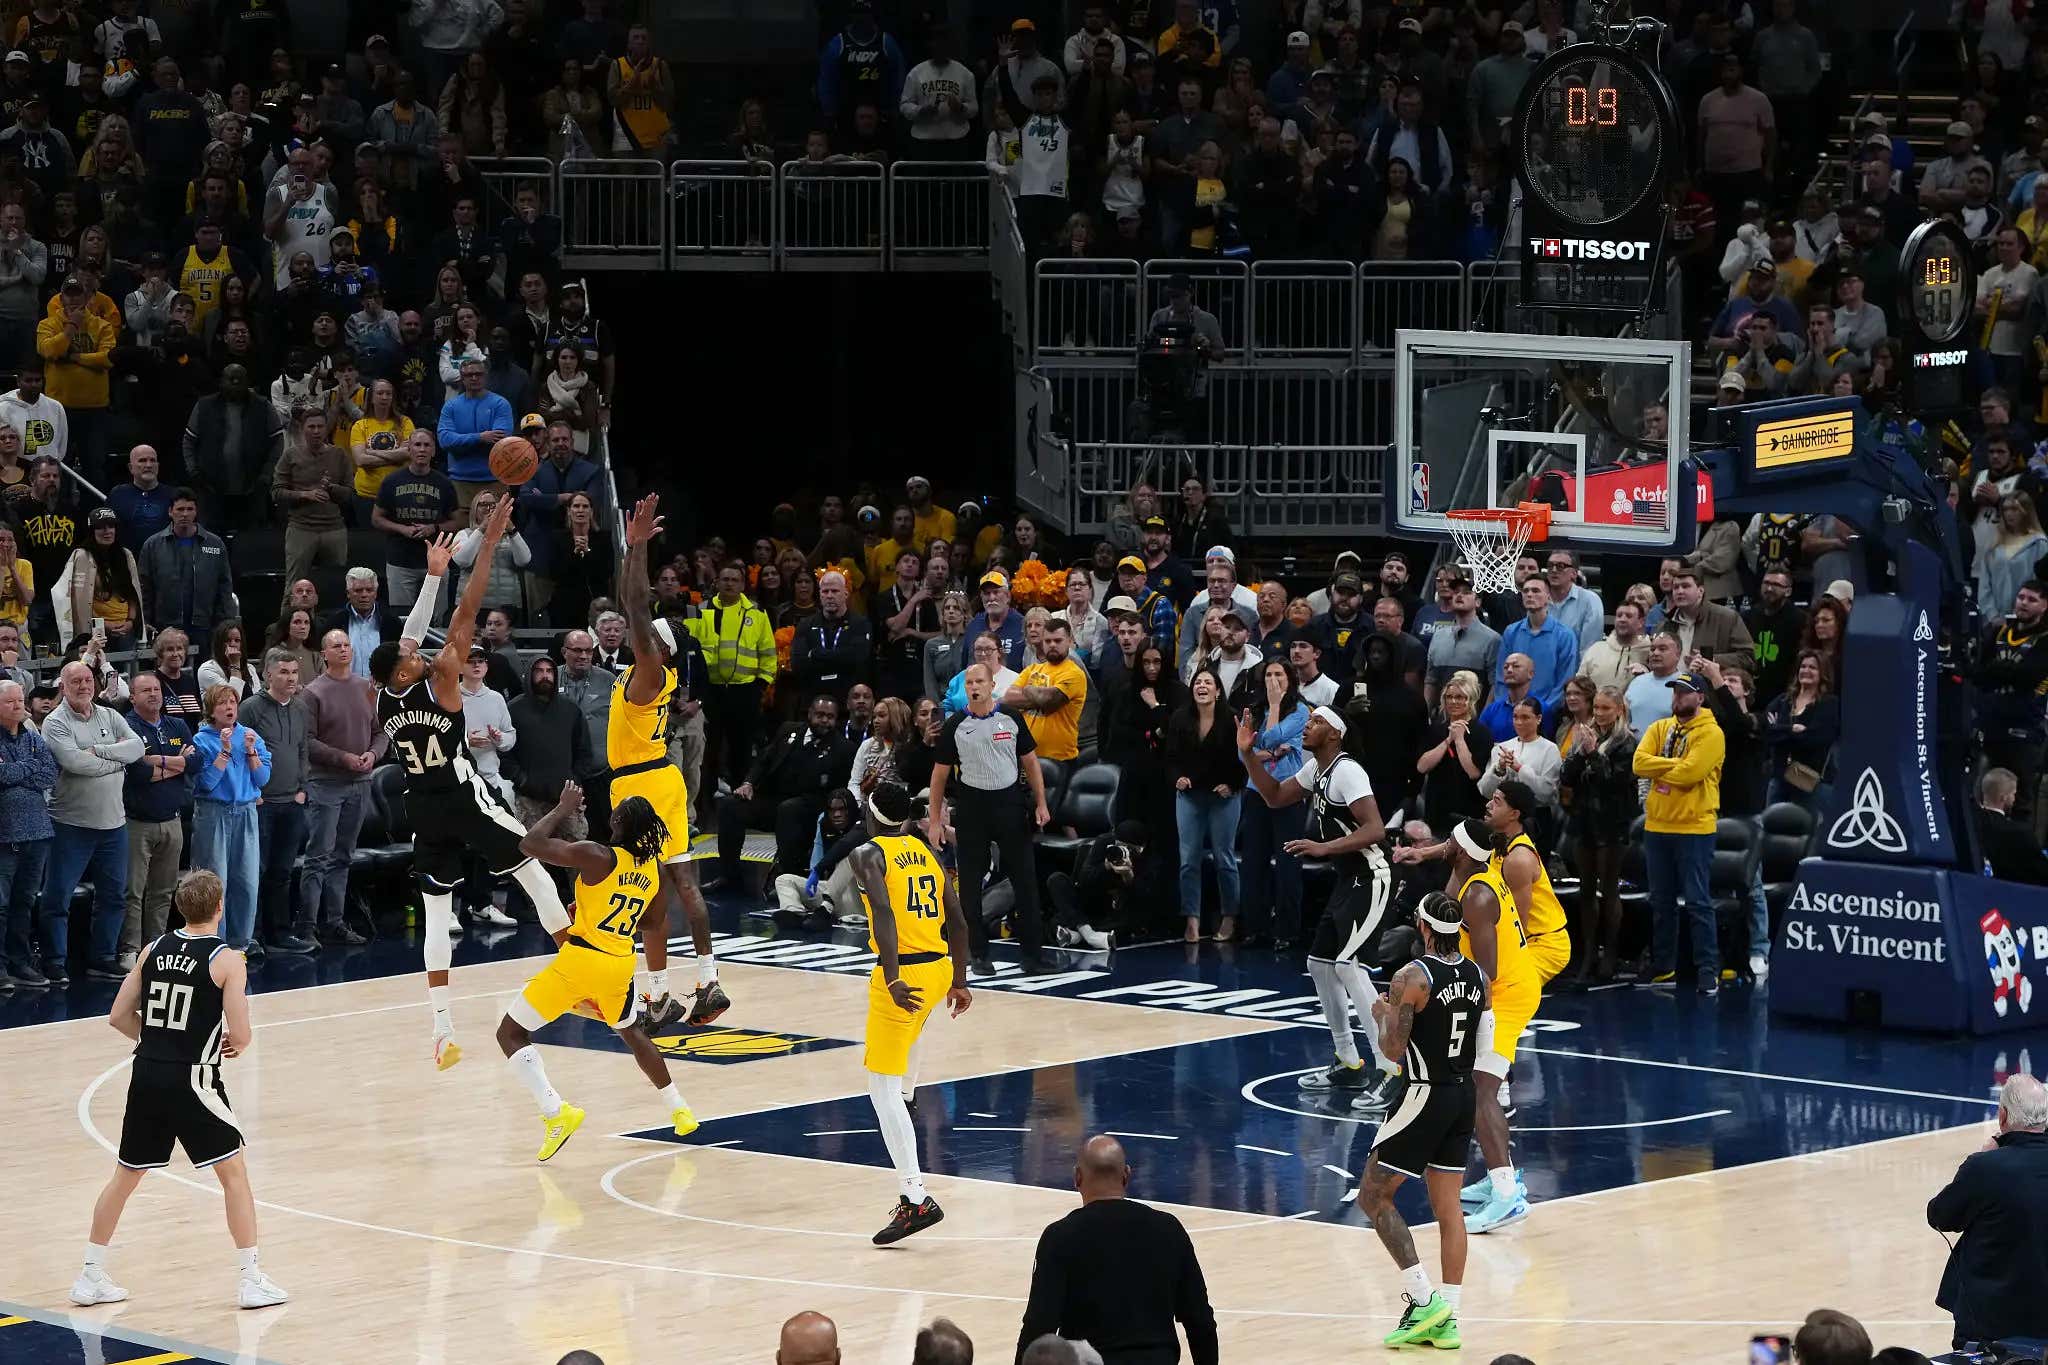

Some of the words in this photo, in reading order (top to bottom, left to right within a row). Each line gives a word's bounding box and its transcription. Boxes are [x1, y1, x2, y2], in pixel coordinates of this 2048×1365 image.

[848, 50, 879, 63] INDY
[921, 79, 960, 97] PACERS
[1568, 87, 1617, 126] 0.9
[1040, 139, 1058, 151] 43
[305, 222, 326, 237] 26
[1563, 240, 1651, 260] TISSOT
[1926, 257, 1950, 285] 0.9
[199, 282, 212, 301] 5
[1929, 350, 1968, 367] TISSOT
[1781, 427, 1839, 451] GAINBRIDGE
[1916, 647, 1928, 740] Ascension
[397, 734, 448, 775] 34
[1916, 744, 1929, 768] St.
[1919, 769, 1941, 842] Vincent
[894, 851, 927, 870] SIAKAM
[618, 872, 652, 892] NESMITH
[907, 875, 939, 919] 43
[1787, 882, 1942, 923] Ascension
[596, 893, 645, 937] 23
[1785, 921, 1825, 953] St.
[1828, 924, 1947, 963] Vincent
[156, 954, 198, 975] GREEN
[1436, 981, 1467, 1006] TRENT
[1467, 985, 1481, 1006] JR
[145, 981, 194, 1031] 20
[1447, 1012, 1468, 1058] 5
